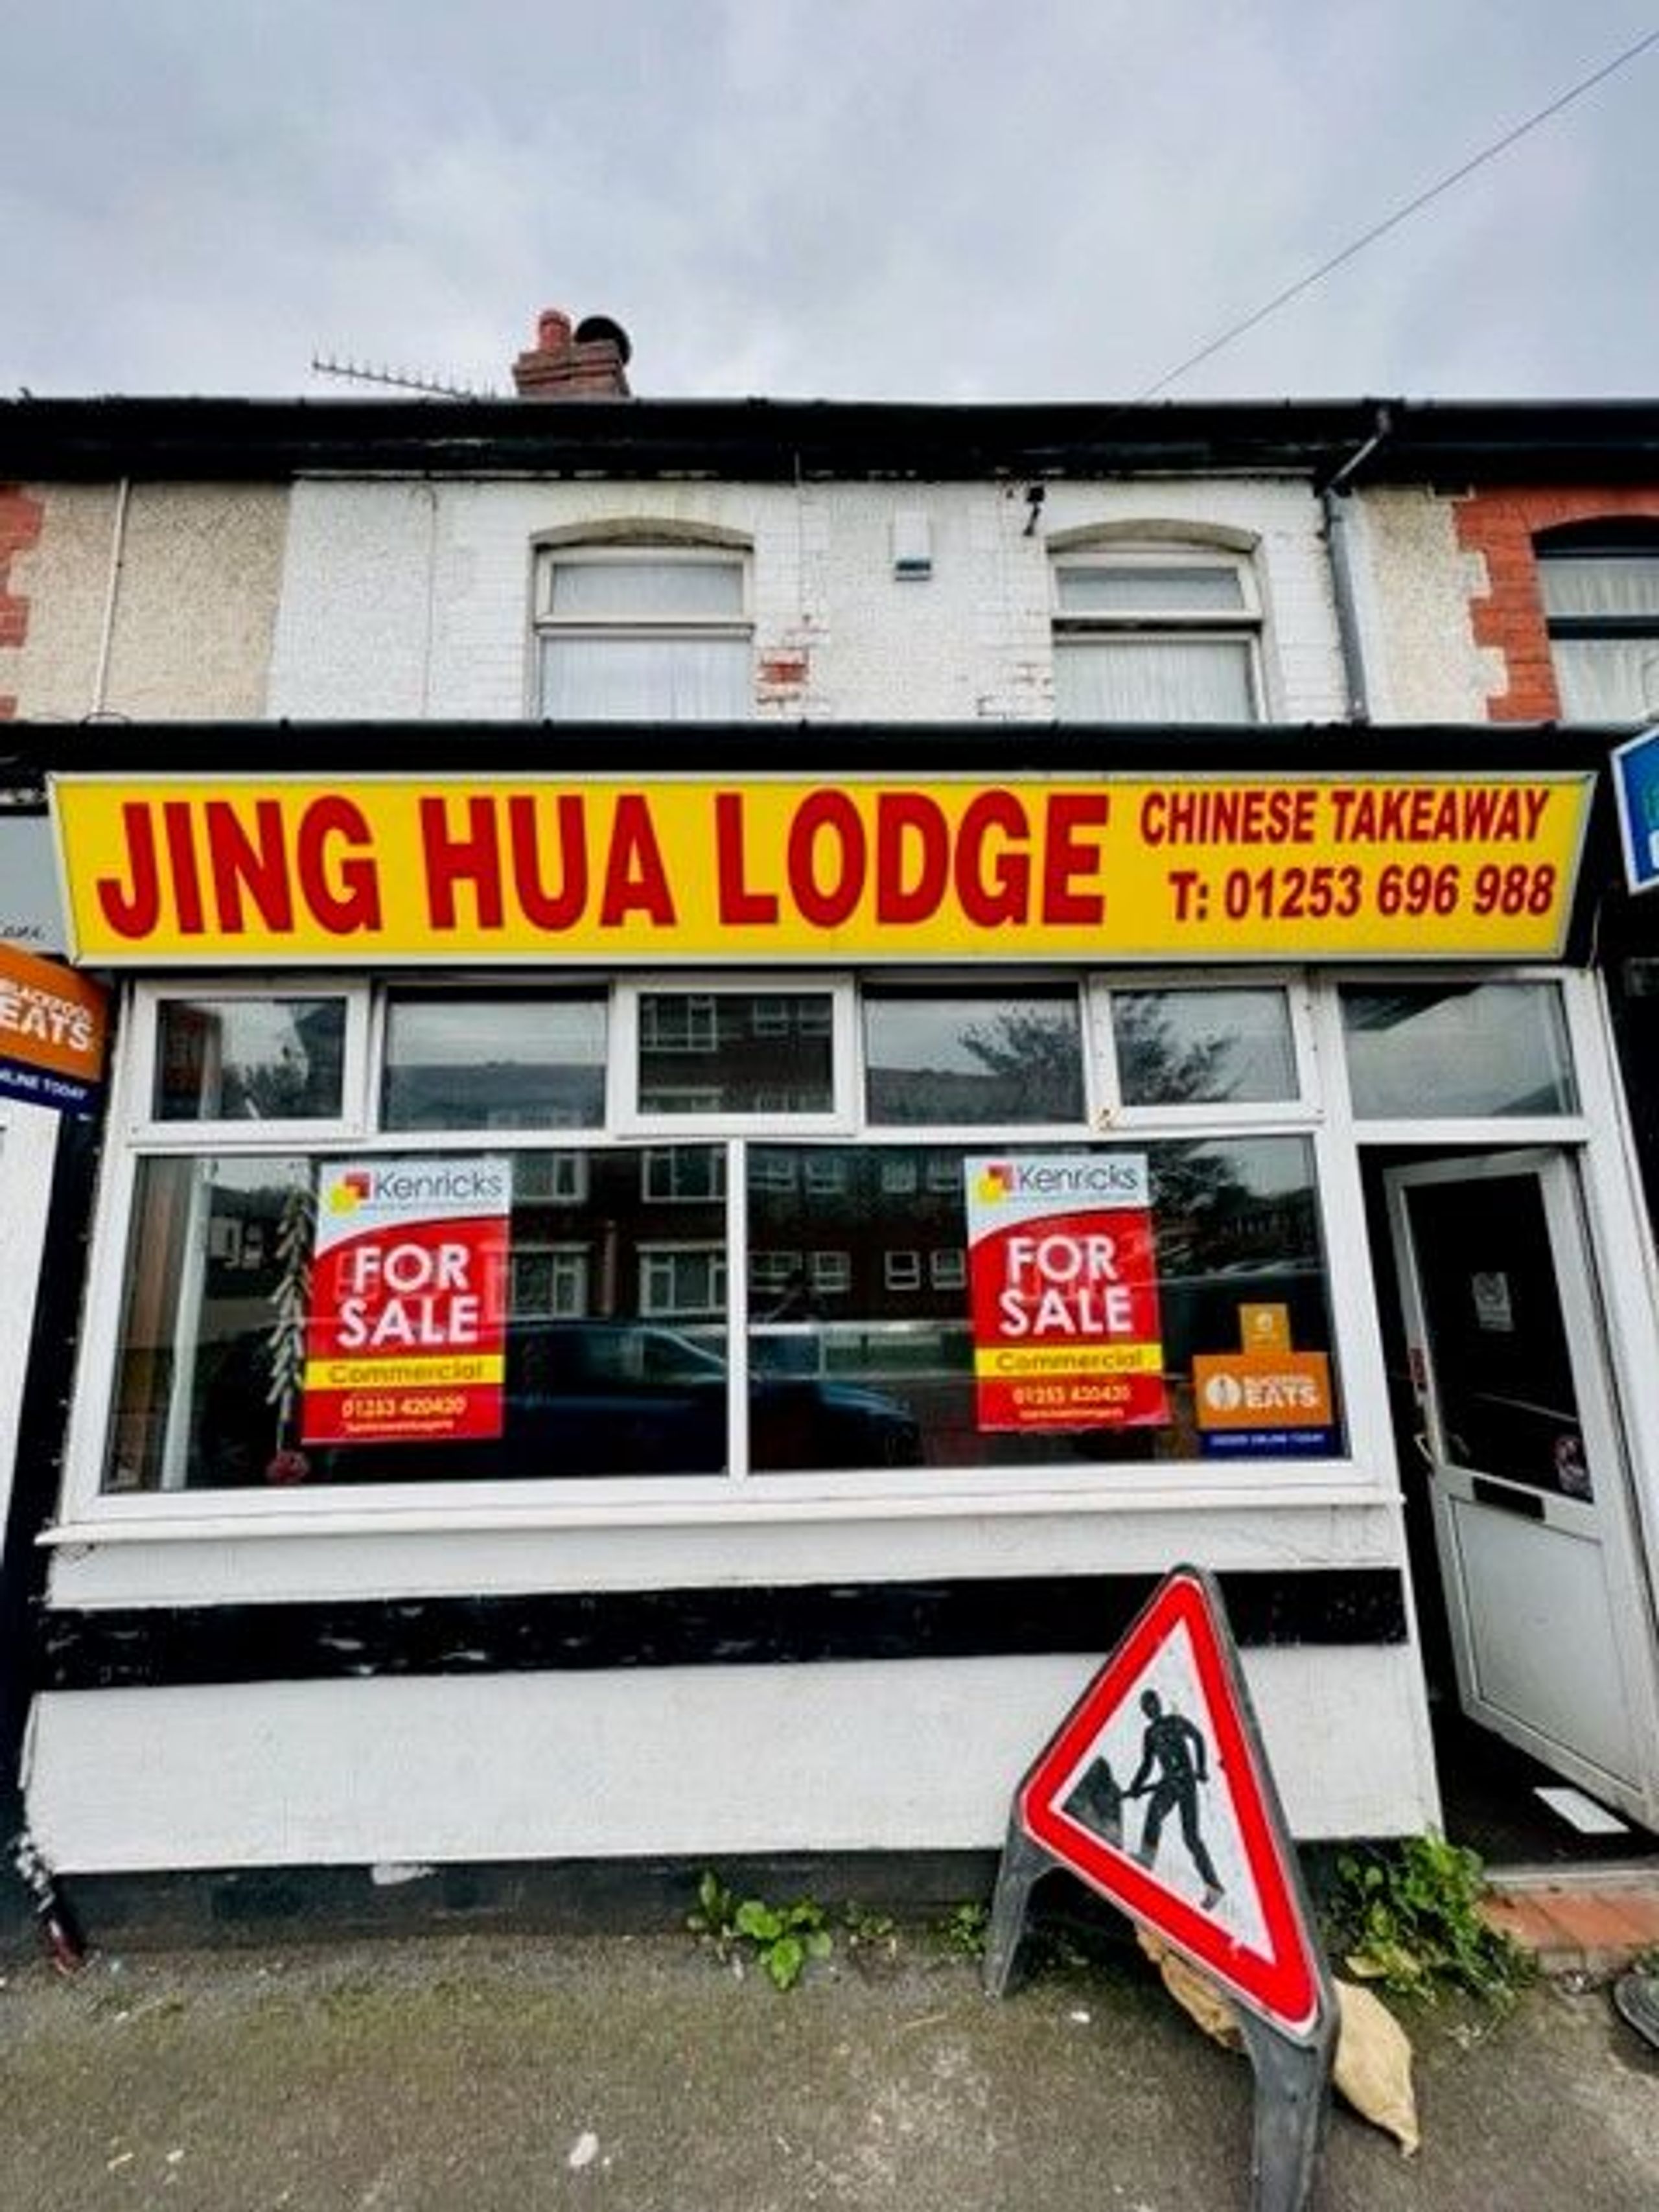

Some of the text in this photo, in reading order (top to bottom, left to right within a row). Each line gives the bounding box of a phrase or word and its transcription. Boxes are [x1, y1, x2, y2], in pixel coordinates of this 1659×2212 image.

[1141, 788, 1550, 845] CHINESE TAKEAWAY
[95, 787, 1109, 940] JING HUA LODGE
[1168, 863, 1556, 921] T: 01253 696 988
[0, 995, 92, 1051] EATS
[376, 1170, 504, 1200] Kenricks
[1017, 1163, 1139, 1191] Kenricks
[354, 1244, 470, 1294] FOR
[1007, 1235, 1119, 1283] FOR
[337, 1295, 479, 1347] SALE
[999, 1285, 1133, 1336] SALE
[329, 1360, 482, 1383] Commercial
[996, 1347, 1143, 1370] Commercial
[1245, 1384, 1319, 1408] EATS
